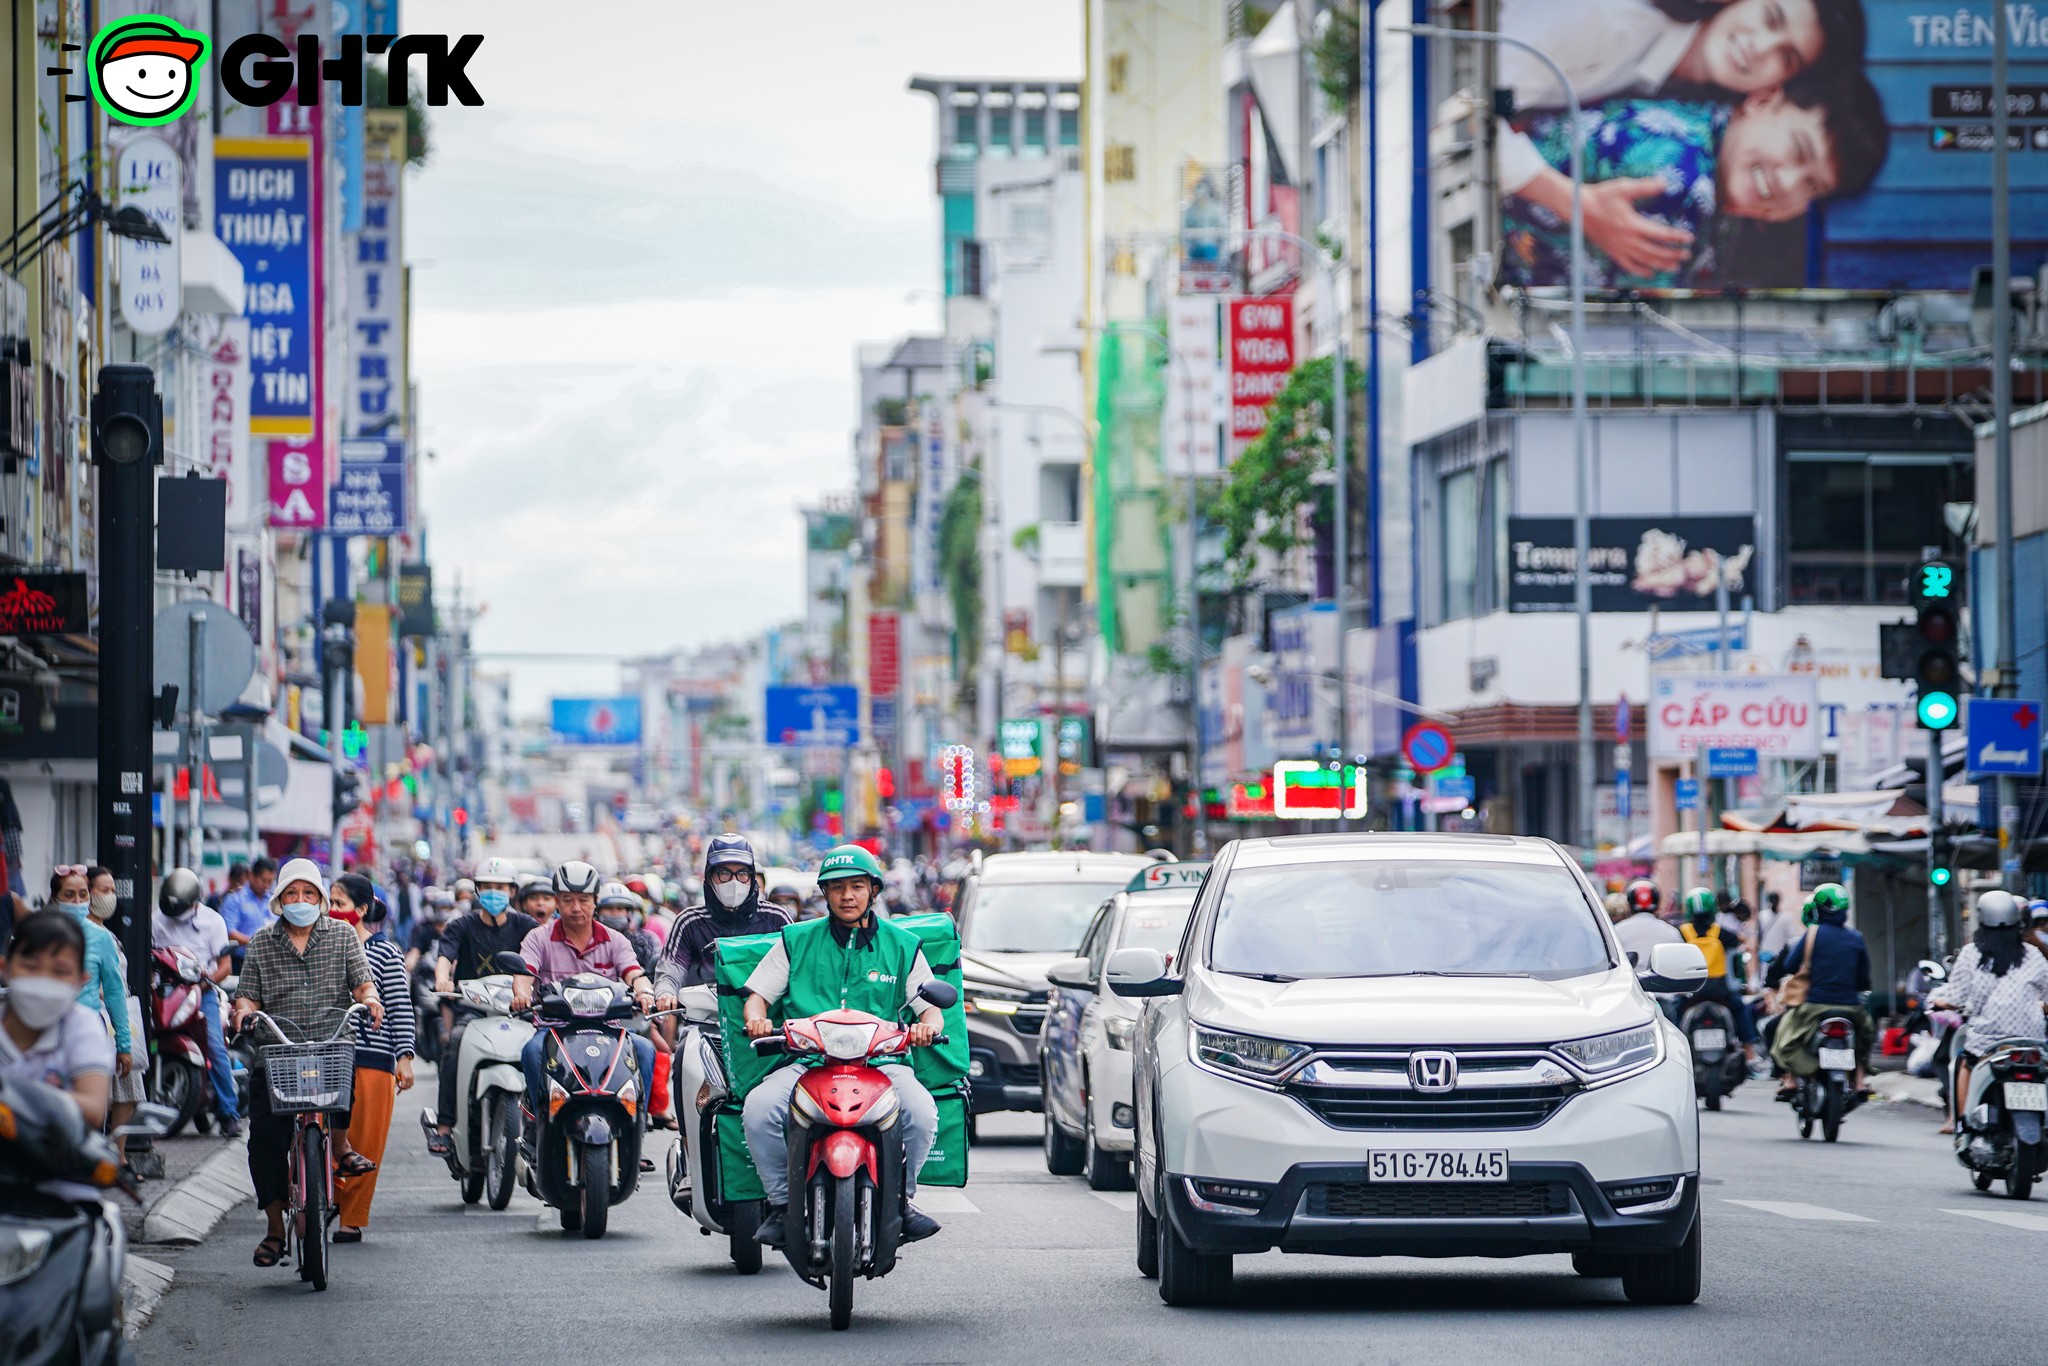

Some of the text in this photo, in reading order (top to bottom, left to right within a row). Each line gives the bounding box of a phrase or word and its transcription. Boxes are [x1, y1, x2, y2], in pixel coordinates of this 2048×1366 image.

[1908, 8, 1995, 47] TRÊN
[229, 168, 295, 206] DỊCH
[220, 208, 305, 252] THUẬT
[252, 322, 293, 365] IỆT
[262, 367, 308, 405] TÍN
[1661, 692, 1808, 728] CẤP CỨU
[824, 855, 855, 868] GHTK
[1373, 1152, 1503, 1178] 51G-784.45
